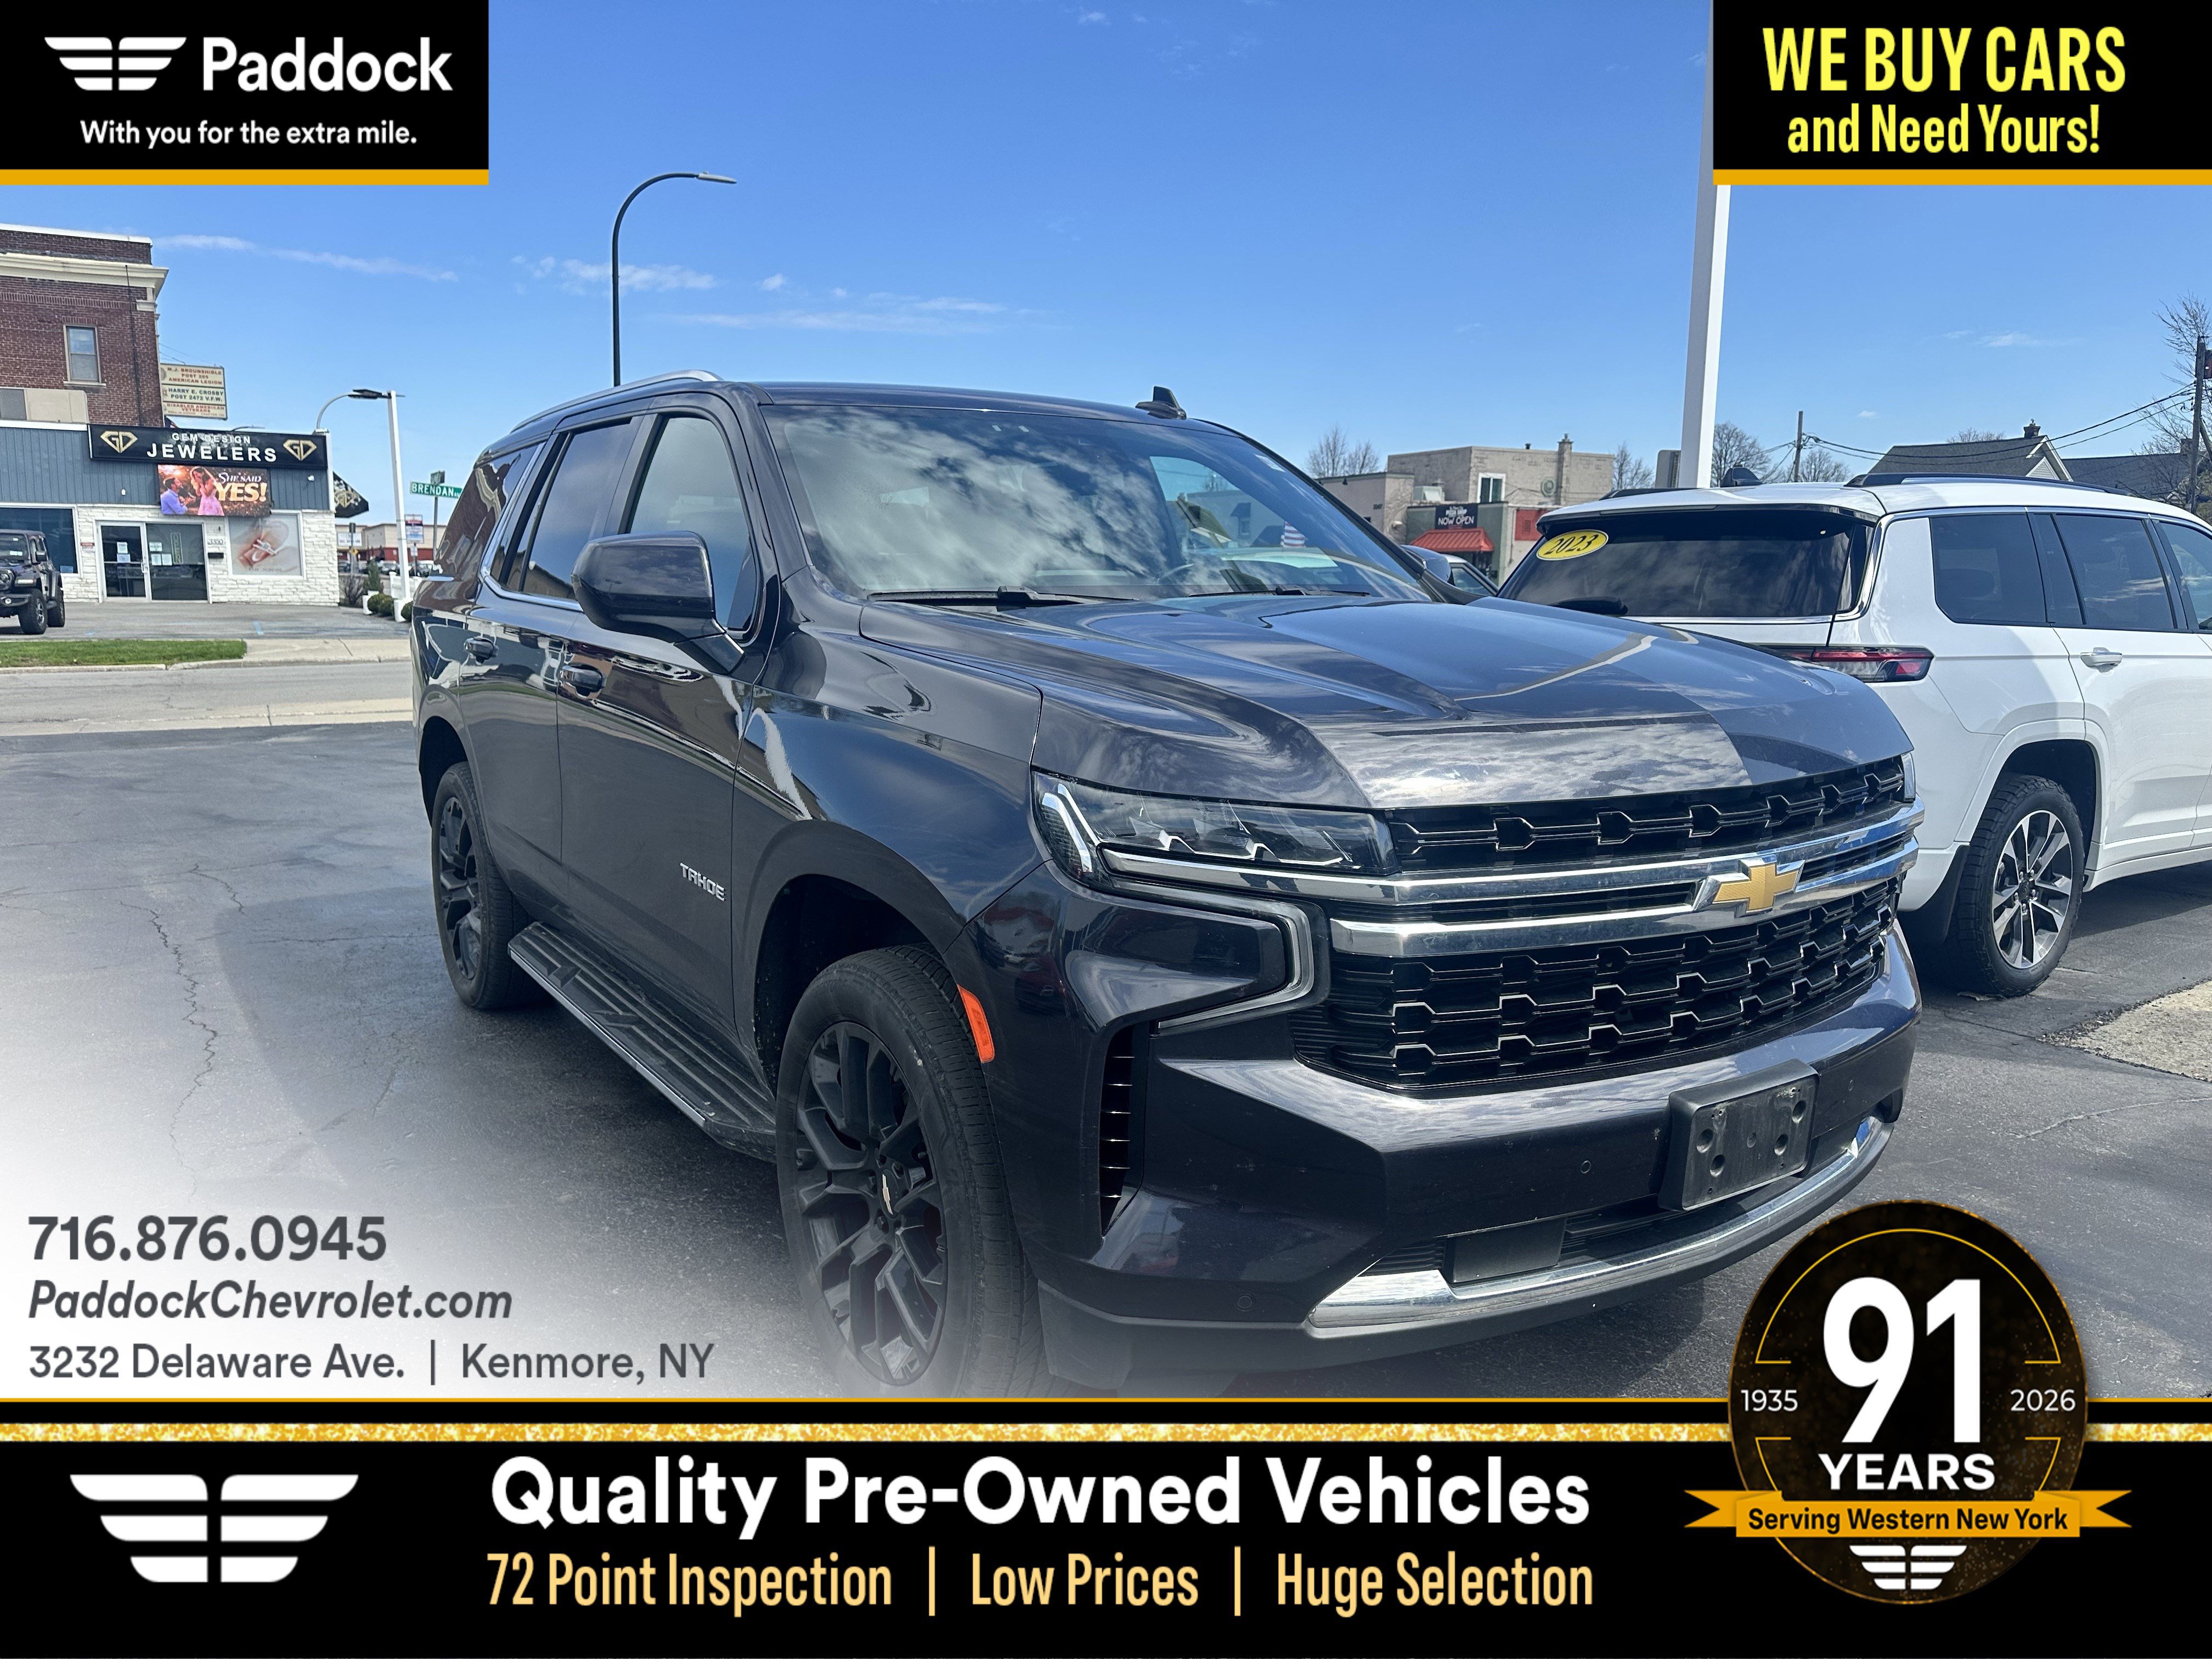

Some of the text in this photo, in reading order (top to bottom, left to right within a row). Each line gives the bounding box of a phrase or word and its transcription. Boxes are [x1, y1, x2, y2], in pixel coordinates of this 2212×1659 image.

[172, 432, 251, 444] GEM DESIGN
[146, 443, 276, 462] JEWELERS
[215, 482, 267, 502] YES!
[411, 483, 454, 496] BRENDAN
[1438, 516, 1475, 526] NOW OPEN
[1543, 534, 1599, 555] 2023
[680, 862, 725, 901] TAHOE
